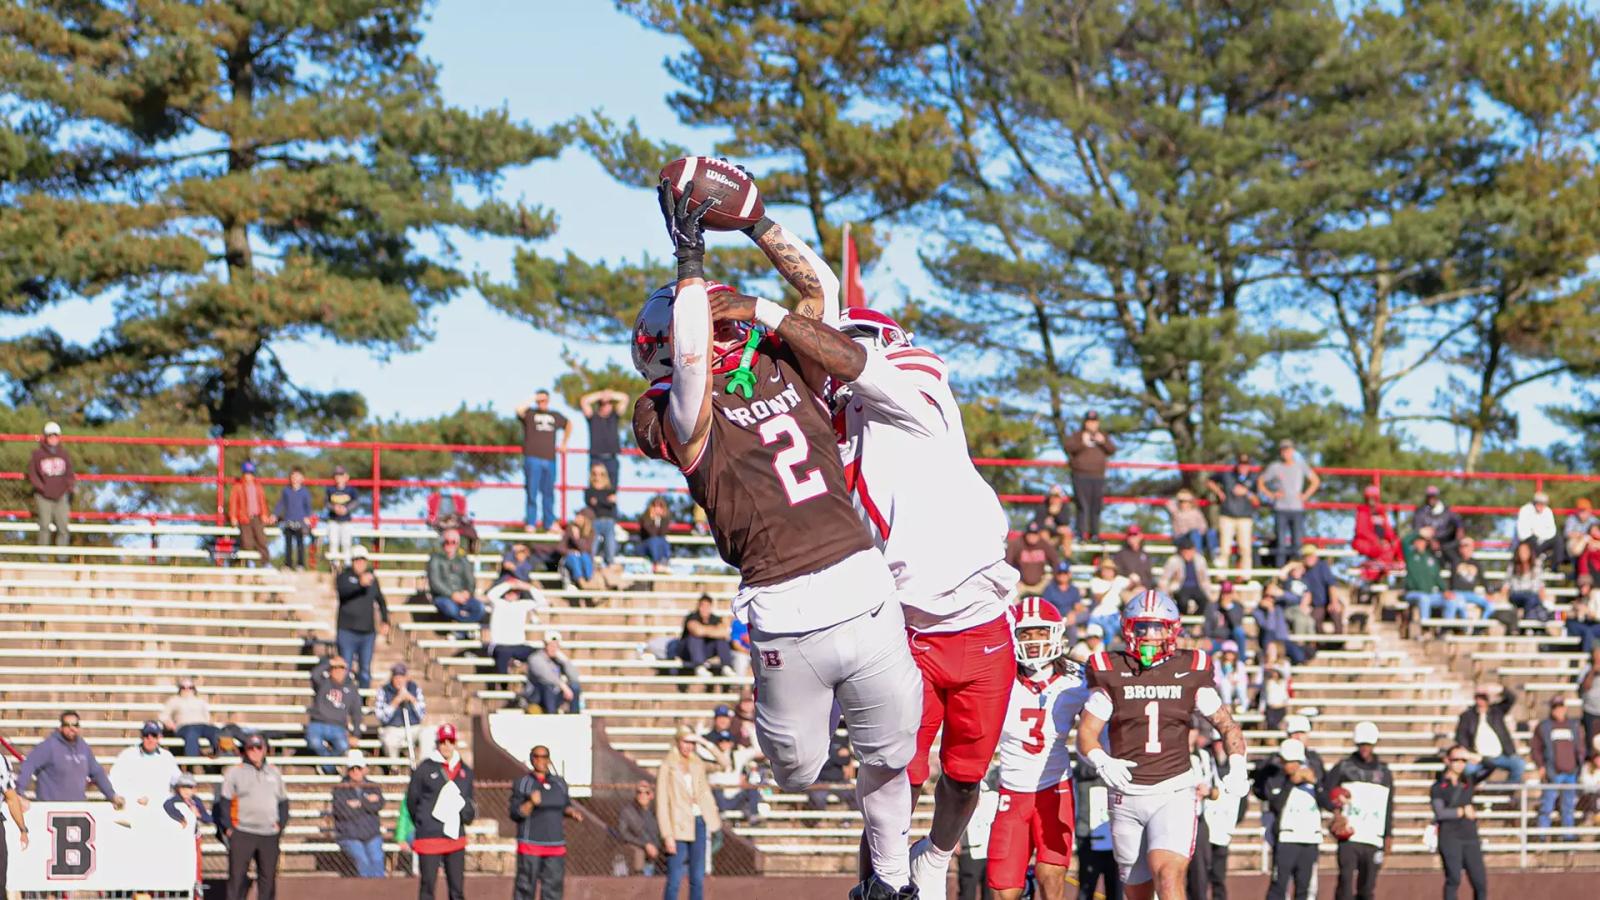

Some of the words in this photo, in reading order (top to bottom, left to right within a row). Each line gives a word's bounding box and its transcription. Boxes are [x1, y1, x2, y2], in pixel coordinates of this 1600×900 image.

[706, 169, 741, 191] Wilson
[758, 413, 830, 506] 2
[761, 649, 782, 668] B
[1123, 685, 1182, 699] BROWN
[1020, 708, 1046, 755] 3
[1144, 700, 1162, 753] 1
[999, 794, 1011, 811] C
[48, 812, 95, 879] B
